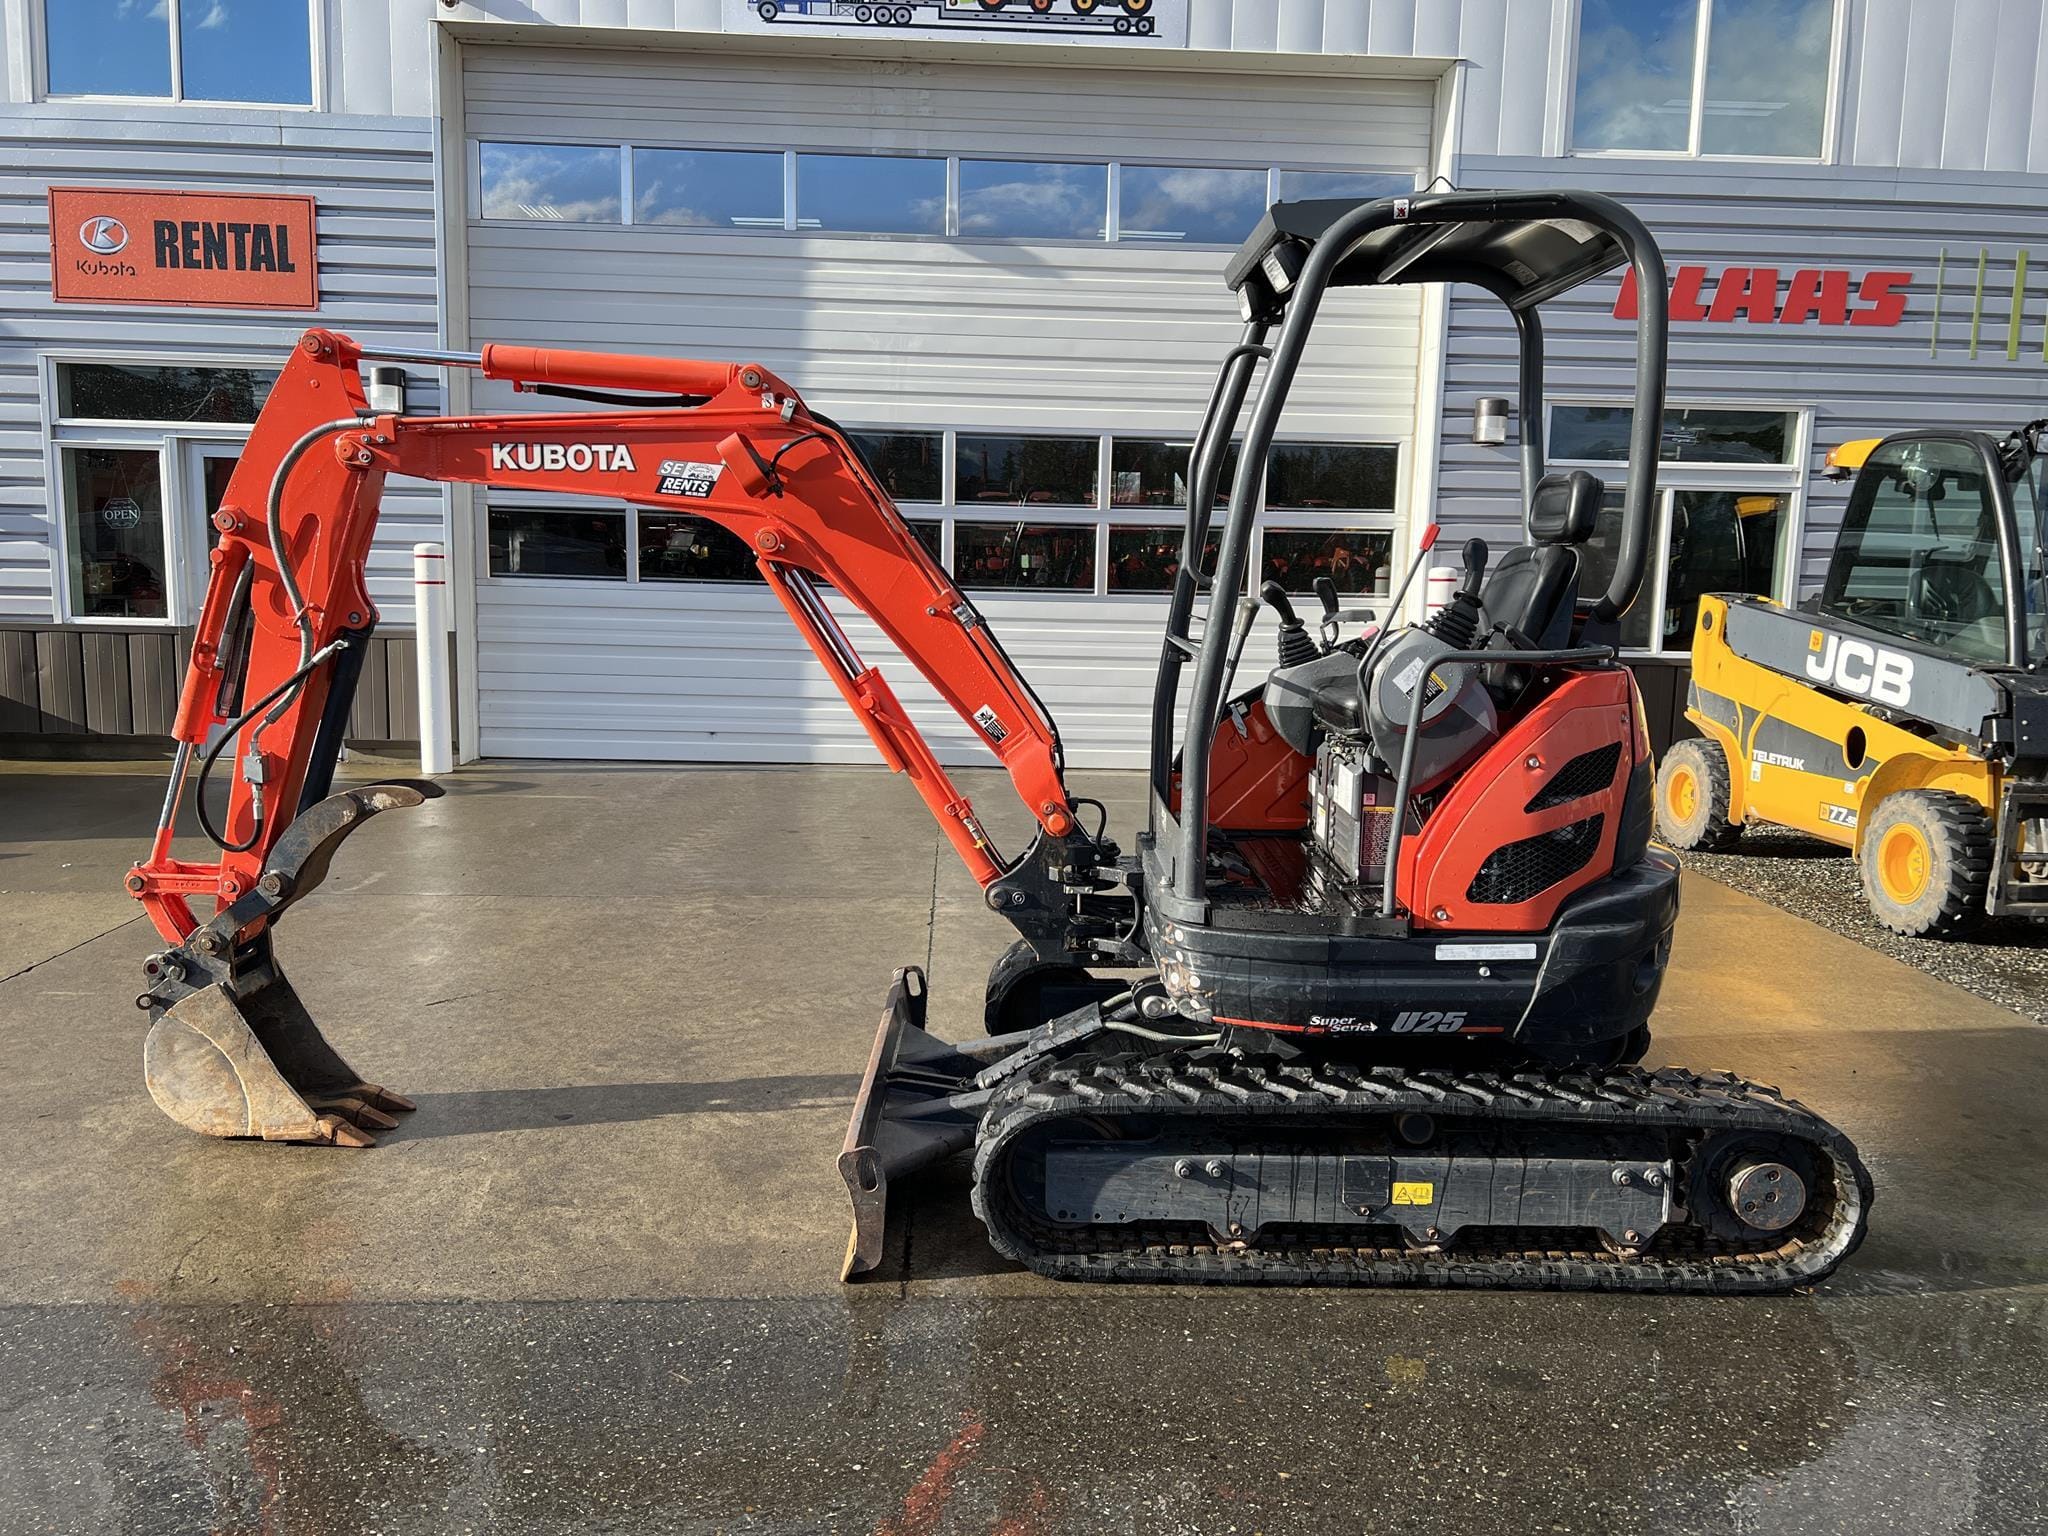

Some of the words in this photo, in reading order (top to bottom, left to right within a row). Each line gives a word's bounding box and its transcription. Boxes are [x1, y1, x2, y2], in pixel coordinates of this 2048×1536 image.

[153, 220, 296, 273] RENTAL
[76, 259, 136, 277] Kubota
[492, 443, 636, 472] KUBOTA
[660, 461, 685, 475] SE
[662, 477, 710, 493] RENTS
[104, 509, 138, 520] OPEN
[1806, 634, 1914, 707] JCB
[1752, 749, 1805, 771] TELETRUK
[1310, 1016, 1356, 1028] Super
[1391, 1012, 1468, 1033] U25
